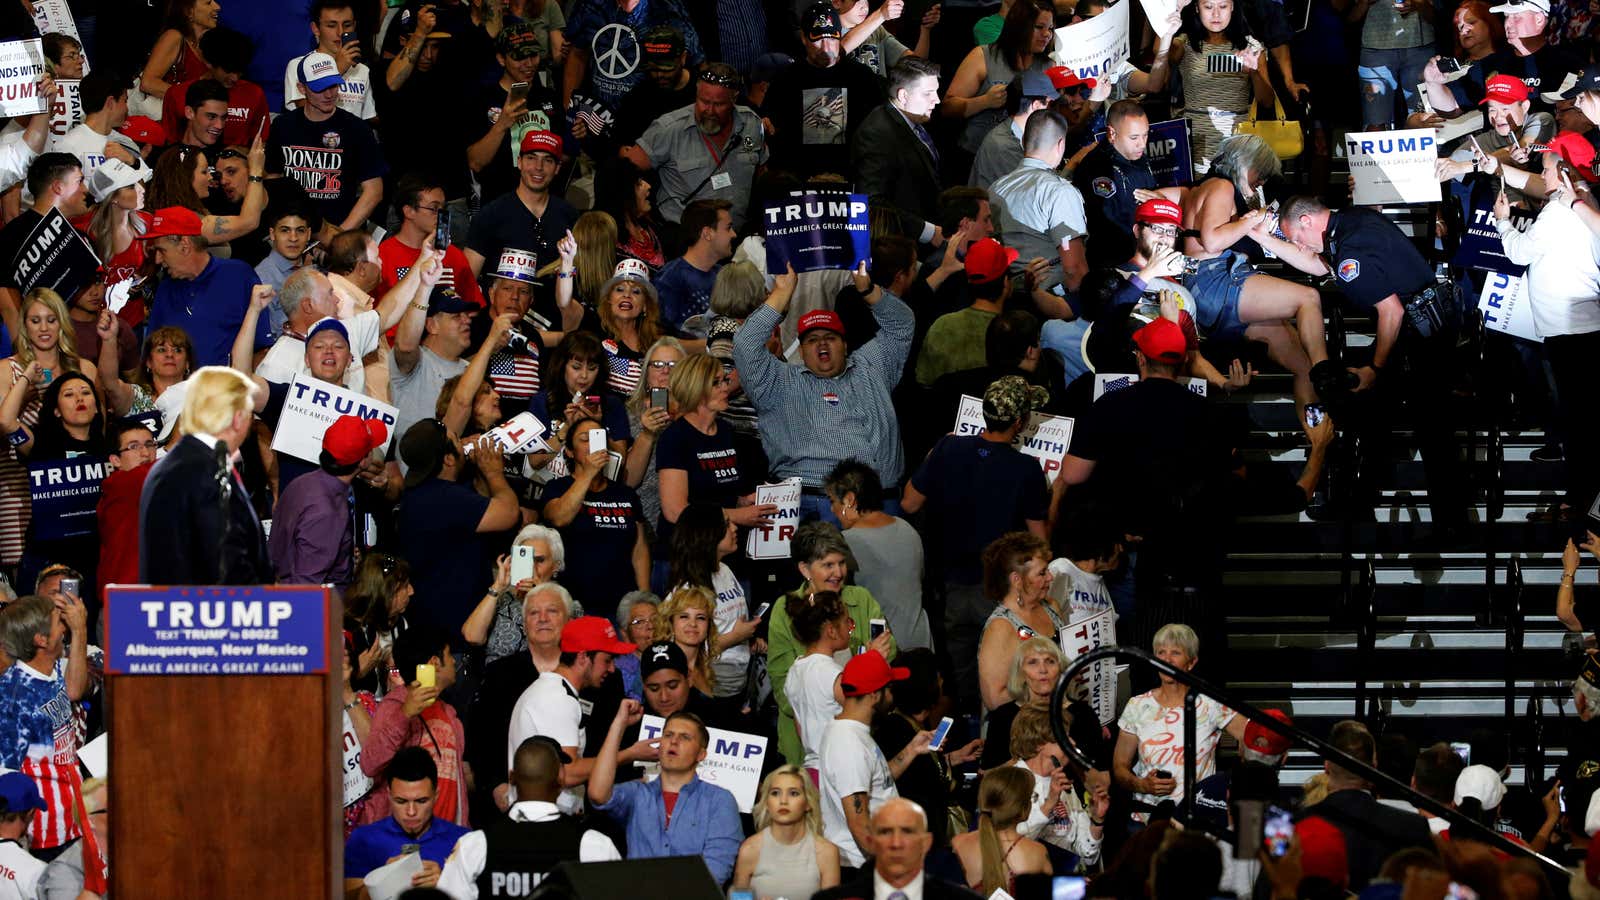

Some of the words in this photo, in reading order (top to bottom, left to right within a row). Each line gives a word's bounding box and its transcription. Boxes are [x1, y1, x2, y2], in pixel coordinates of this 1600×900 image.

[0, 66, 18, 79] NDS
[339, 81, 365, 95] UMP
[1347, 136, 1434, 156] TRUMP
[281, 146, 342, 171] DONALD
[765, 201, 867, 224] TRUMP
[766, 227, 788, 236] MAKE
[788, 224, 821, 234] AMERICA
[844, 223, 868, 231] AGAIN!
[1467, 228, 1482, 236] MAKE
[13, 215, 63, 287] TRUMP
[45, 248, 61, 267] GREAT
[1484, 272, 1510, 324] TRU
[288, 404, 310, 416] MAKE
[310, 412, 335, 423] AMERI
[1024, 436, 1065, 455] WITH
[31, 462, 115, 487] TRUMP
[714, 467, 738, 478] 2016
[32, 492, 51, 501] MAKE
[51, 489, 80, 499] AMERICA
[81, 486, 100, 495] GREAT
[761, 492, 779, 504] the
[780, 489, 800, 503] sile
[594, 515, 625, 524] 2016
[140, 600, 293, 628] TRUMP
[155, 630, 179, 640] TEXT
[230, 630, 240, 640] to
[240, 629, 279, 640] 88022
[126, 643, 219, 658] Albuquerque,
[221, 644, 253, 657] New
[256, 644, 308, 657] Mexico
[129, 662, 162, 674] MAKE
[165, 662, 218, 674] AMERICA
[222, 662, 259, 674] GREAT
[262, 662, 305, 674] AGAIN!
[644, 725, 763, 759] TMP
[730, 763, 760, 775] AGAIN!
[490, 871, 551, 896] POLI
